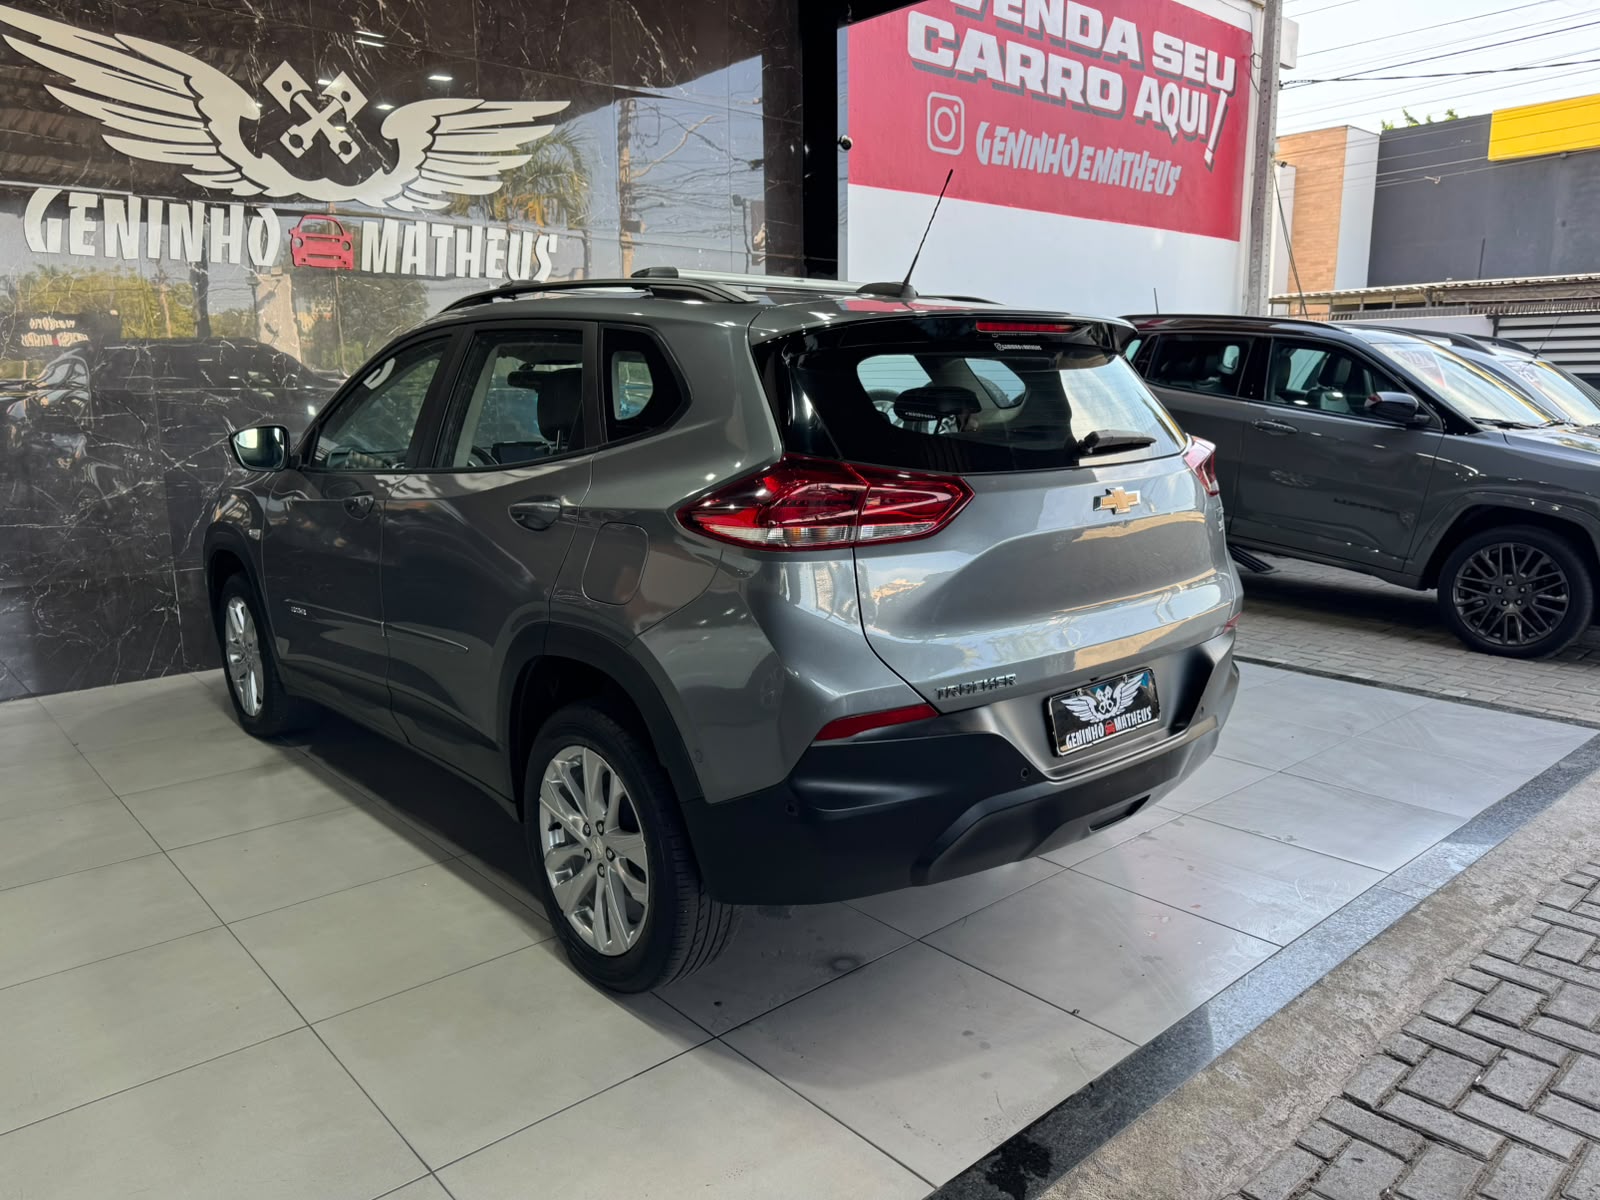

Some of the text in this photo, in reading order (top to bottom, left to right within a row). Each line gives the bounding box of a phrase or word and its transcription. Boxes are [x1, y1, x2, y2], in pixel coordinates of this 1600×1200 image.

[907, 10, 1228, 166] CARRO AQUI!
[949, 0, 1236, 93] ENDA SEU
[23, 187, 558, 282] GENINHO MATHEUS
[1065, 707, 1152, 748] GENINHO MATHEUS
